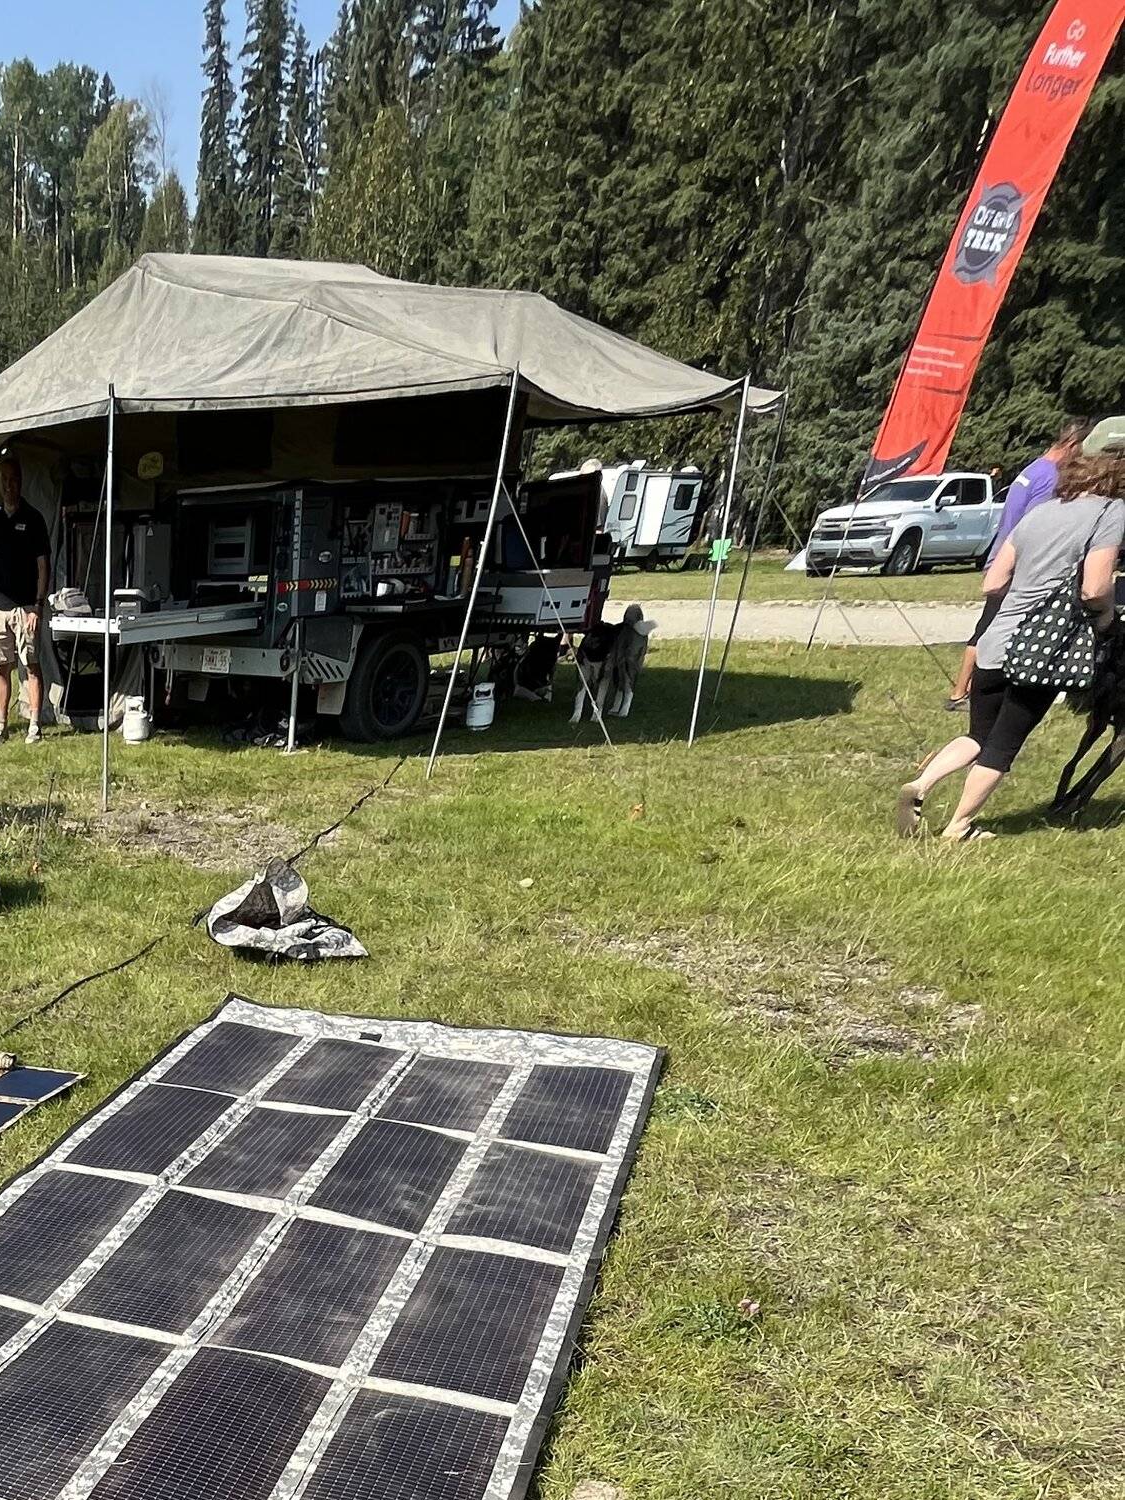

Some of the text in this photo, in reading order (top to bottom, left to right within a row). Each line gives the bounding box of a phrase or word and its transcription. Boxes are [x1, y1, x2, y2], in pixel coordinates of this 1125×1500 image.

[1067, 19, 1087, 41] Go
[1042, 42, 1087, 69] Further
[963, 228, 1008, 252] TREK
